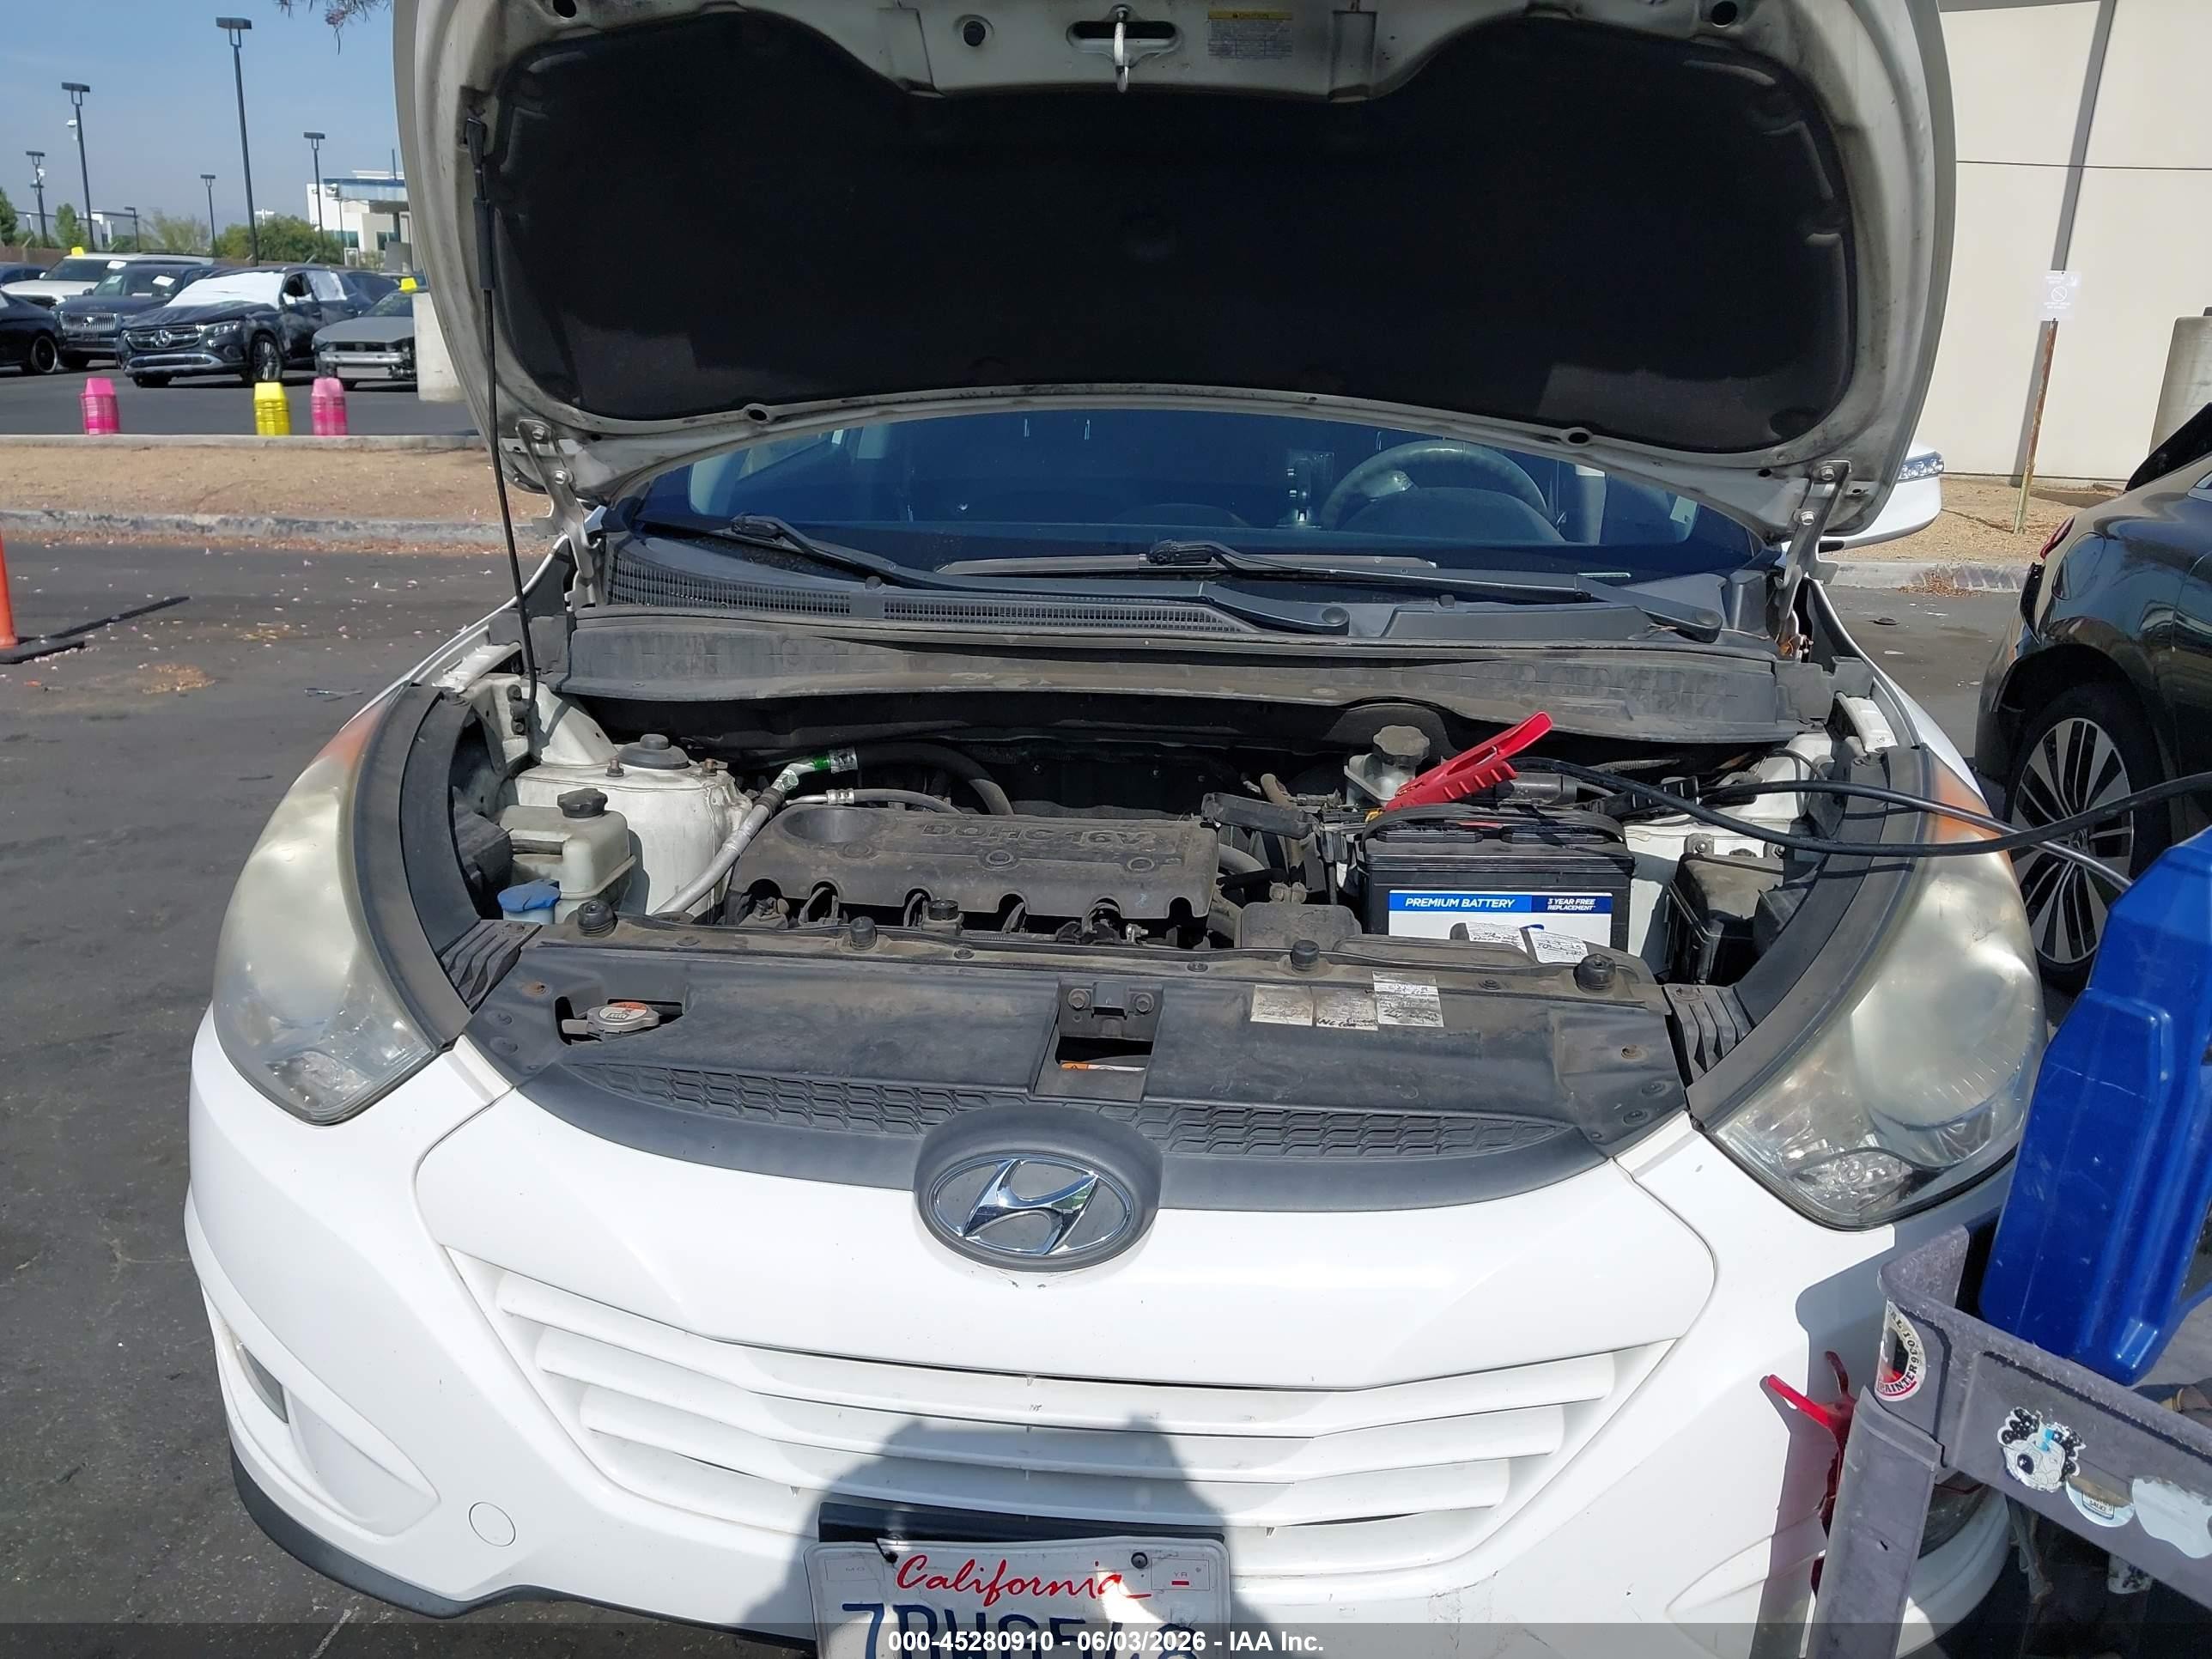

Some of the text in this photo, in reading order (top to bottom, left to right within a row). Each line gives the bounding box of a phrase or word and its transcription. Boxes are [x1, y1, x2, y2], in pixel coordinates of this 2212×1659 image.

[921, 823, 1053, 841] DOHC
[1405, 897, 1515, 908] PREMIUM BATTERY
[897, 1553, 1152, 1607] California
